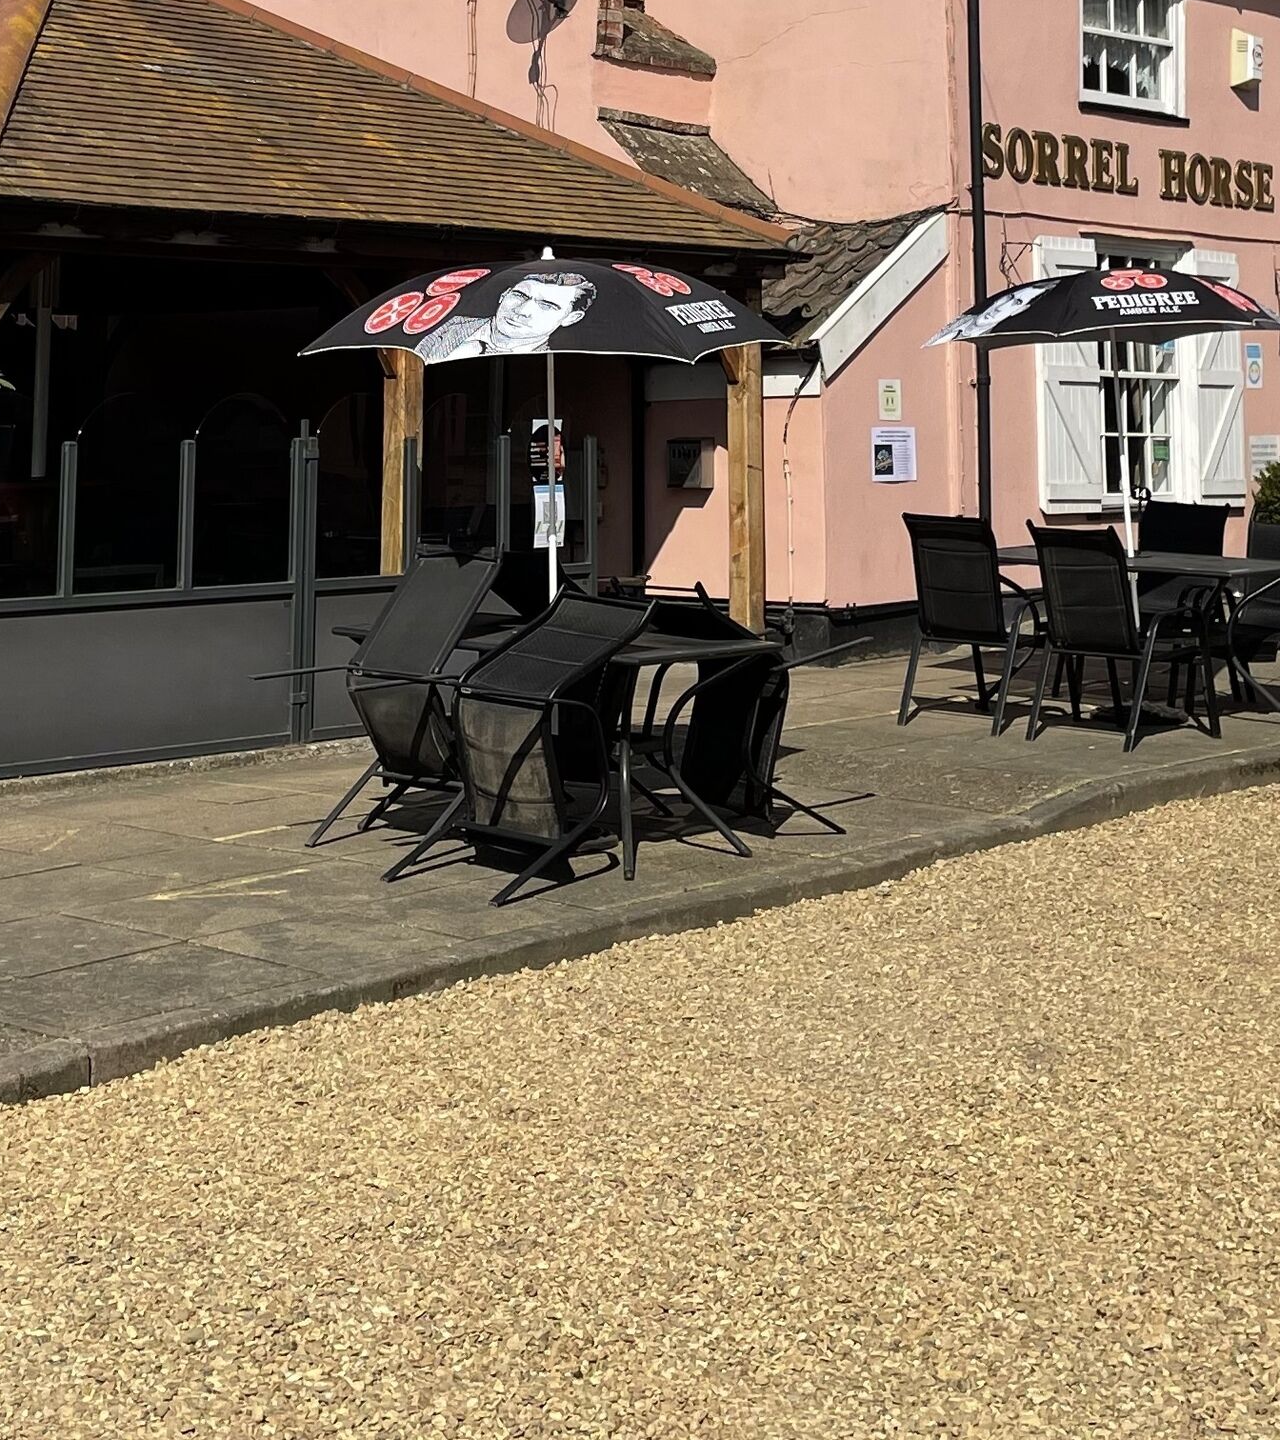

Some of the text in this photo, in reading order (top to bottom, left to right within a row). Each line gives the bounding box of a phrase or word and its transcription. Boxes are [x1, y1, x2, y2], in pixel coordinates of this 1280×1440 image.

[982, 122, 1275, 213] SORREL HORSE
[1091, 291, 1200, 310] PEDIGREE
[664, 299, 736, 326] PEDIGREE
[1119, 305, 1182, 316] AMBER ALE
[1133, 487, 1147, 499] 14
